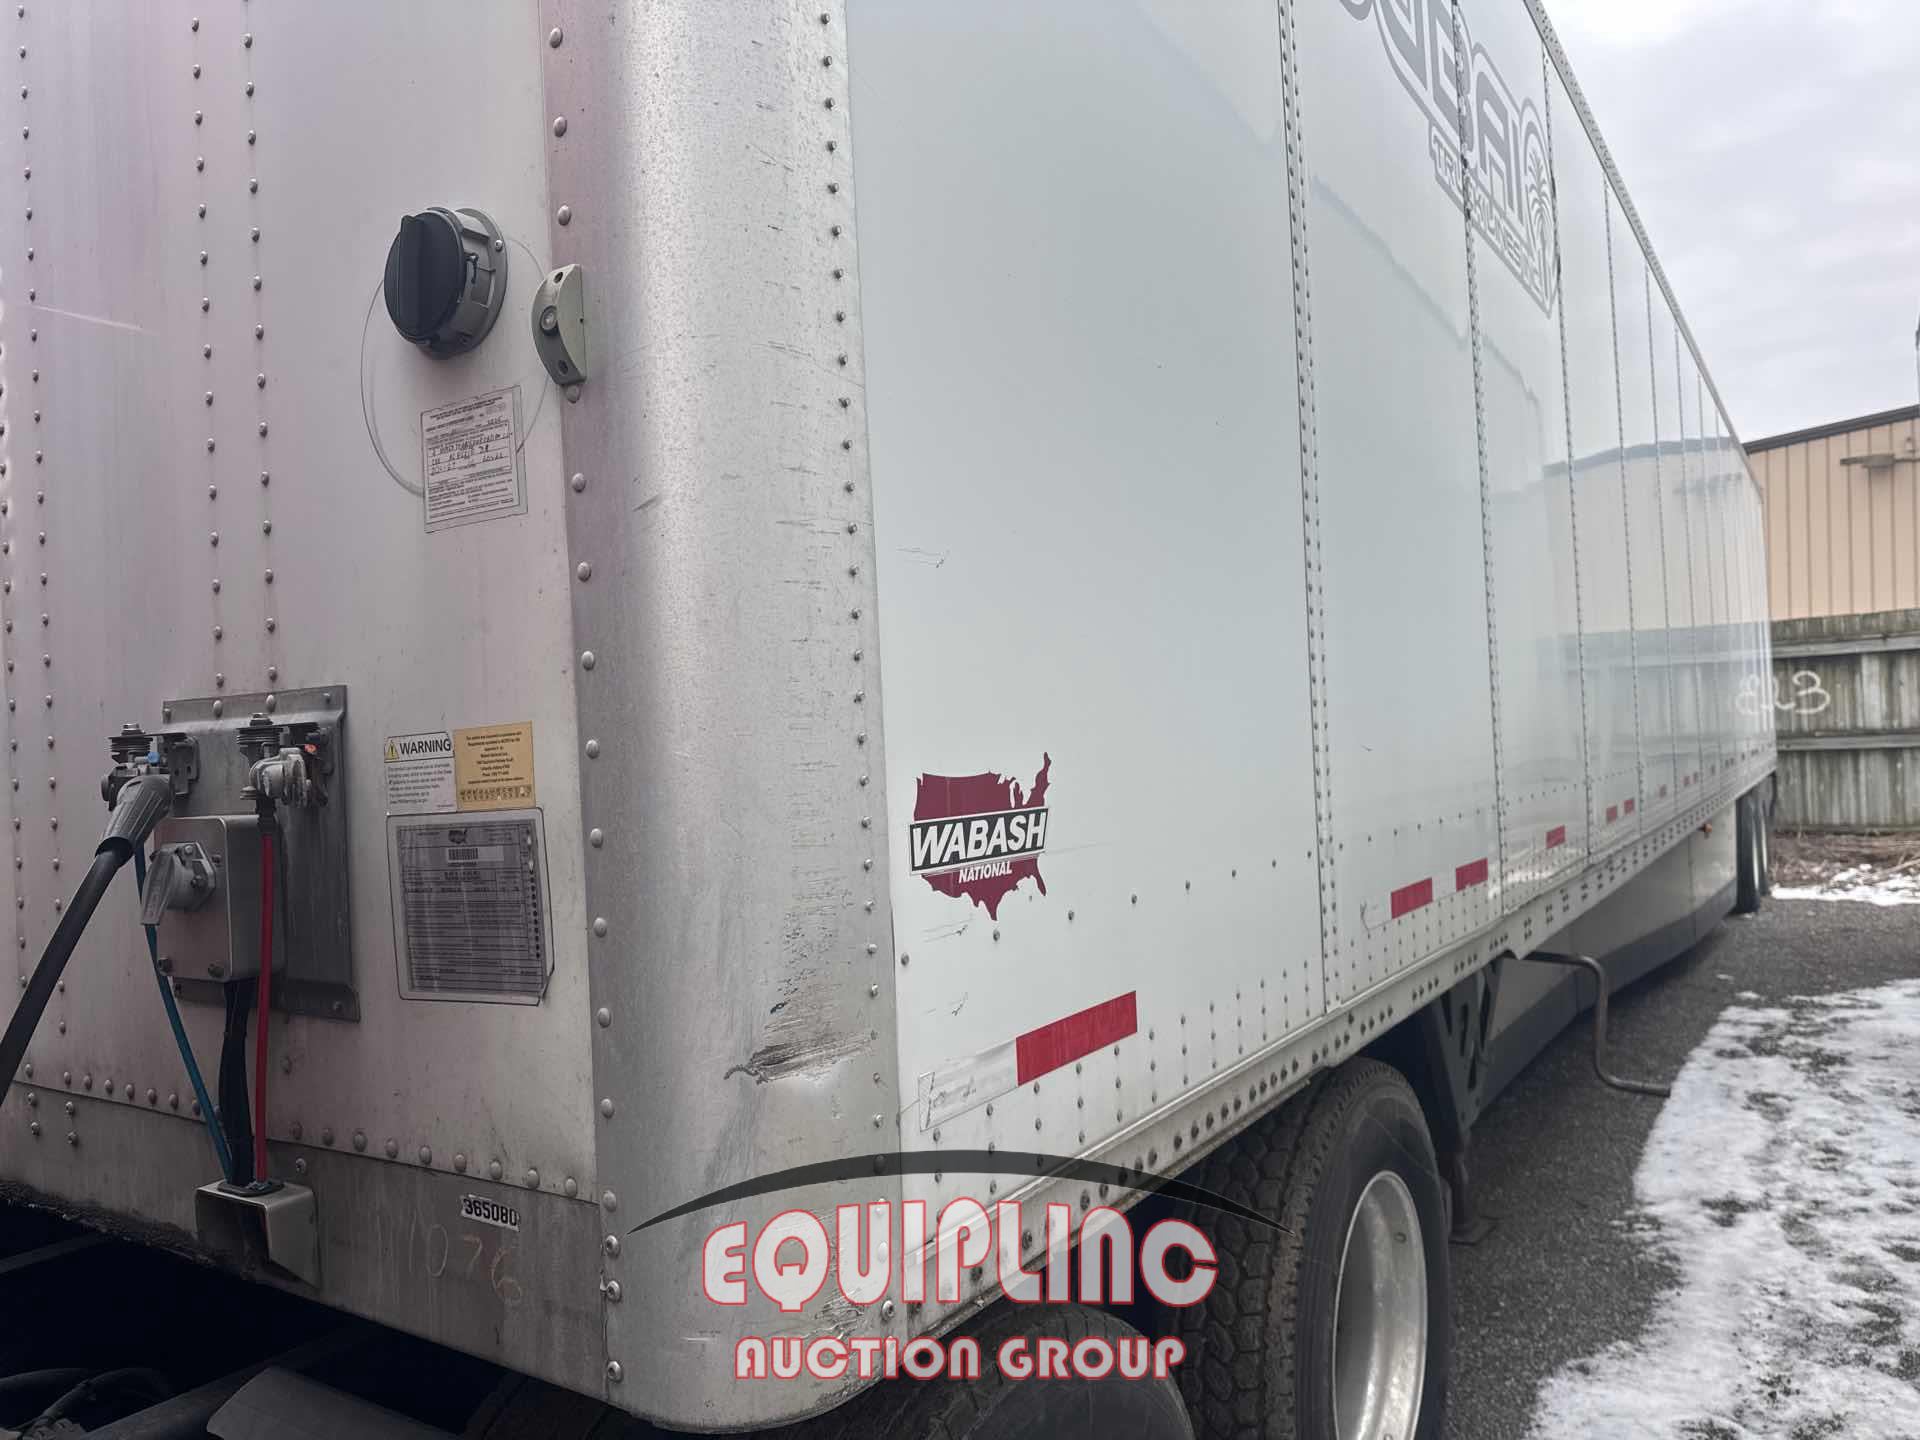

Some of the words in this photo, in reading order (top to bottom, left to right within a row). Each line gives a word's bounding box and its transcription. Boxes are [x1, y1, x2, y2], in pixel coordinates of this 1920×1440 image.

[400, 739, 451, 755] WARNING
[912, 812, 1047, 867] WABASH
[958, 861, 1013, 884] NATIONAL
